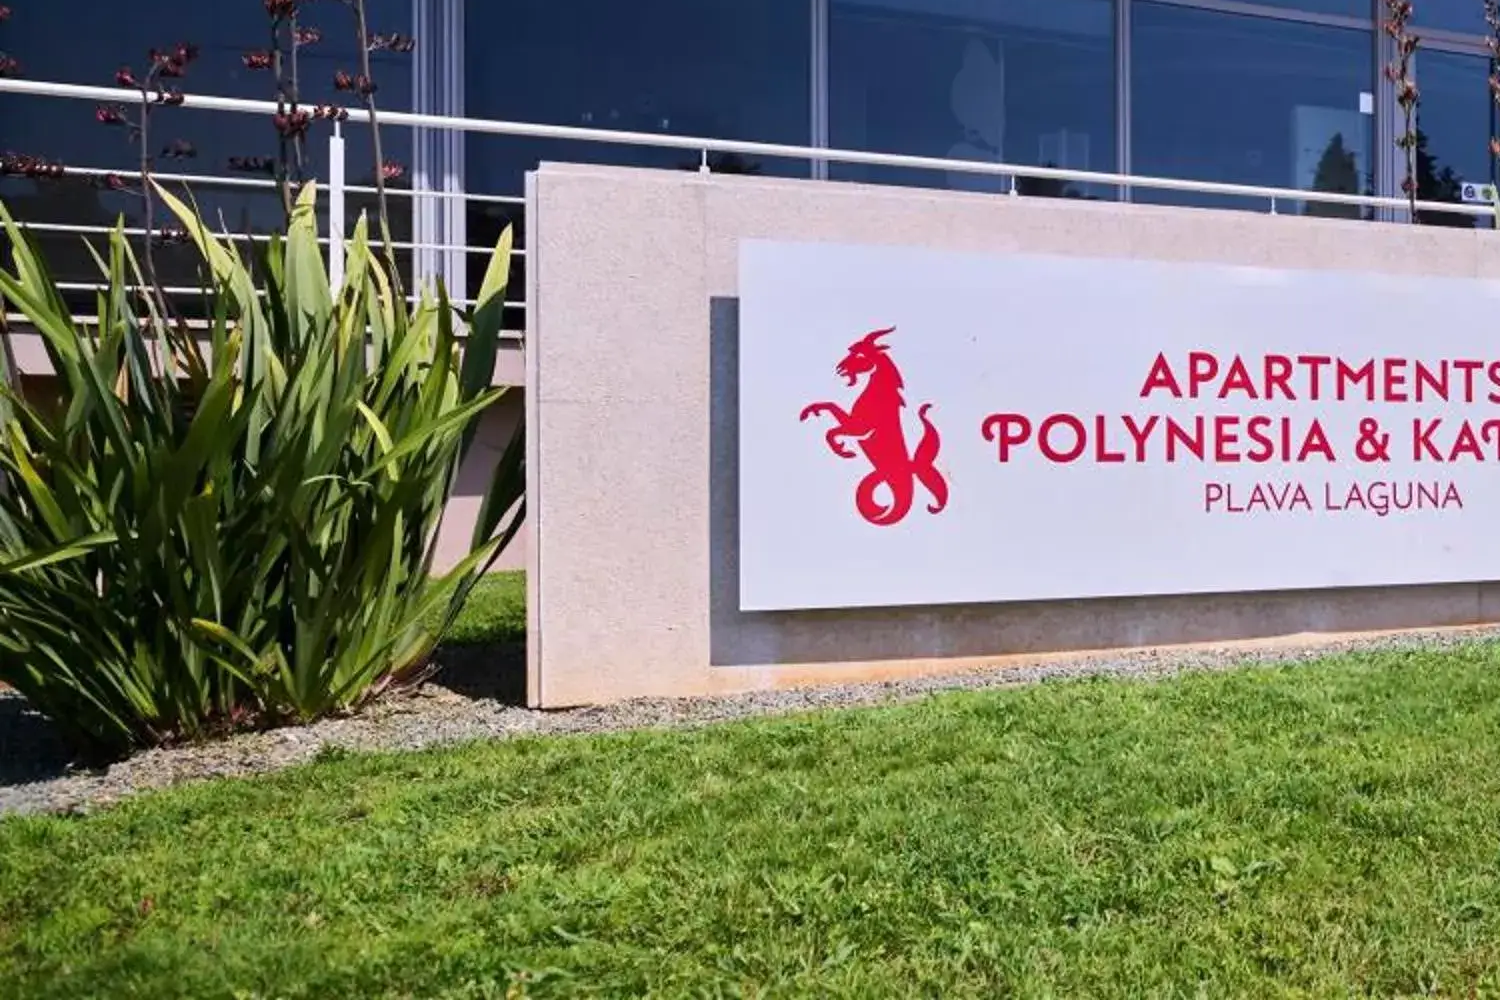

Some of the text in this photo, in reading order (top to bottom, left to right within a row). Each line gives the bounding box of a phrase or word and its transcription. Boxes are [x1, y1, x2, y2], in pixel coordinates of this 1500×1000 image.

[980, 412, 1336, 465] POLYNESIA
[1354, 416, 1391, 464] &
[1203, 480, 1463, 517] PLAVA LAGUNA
